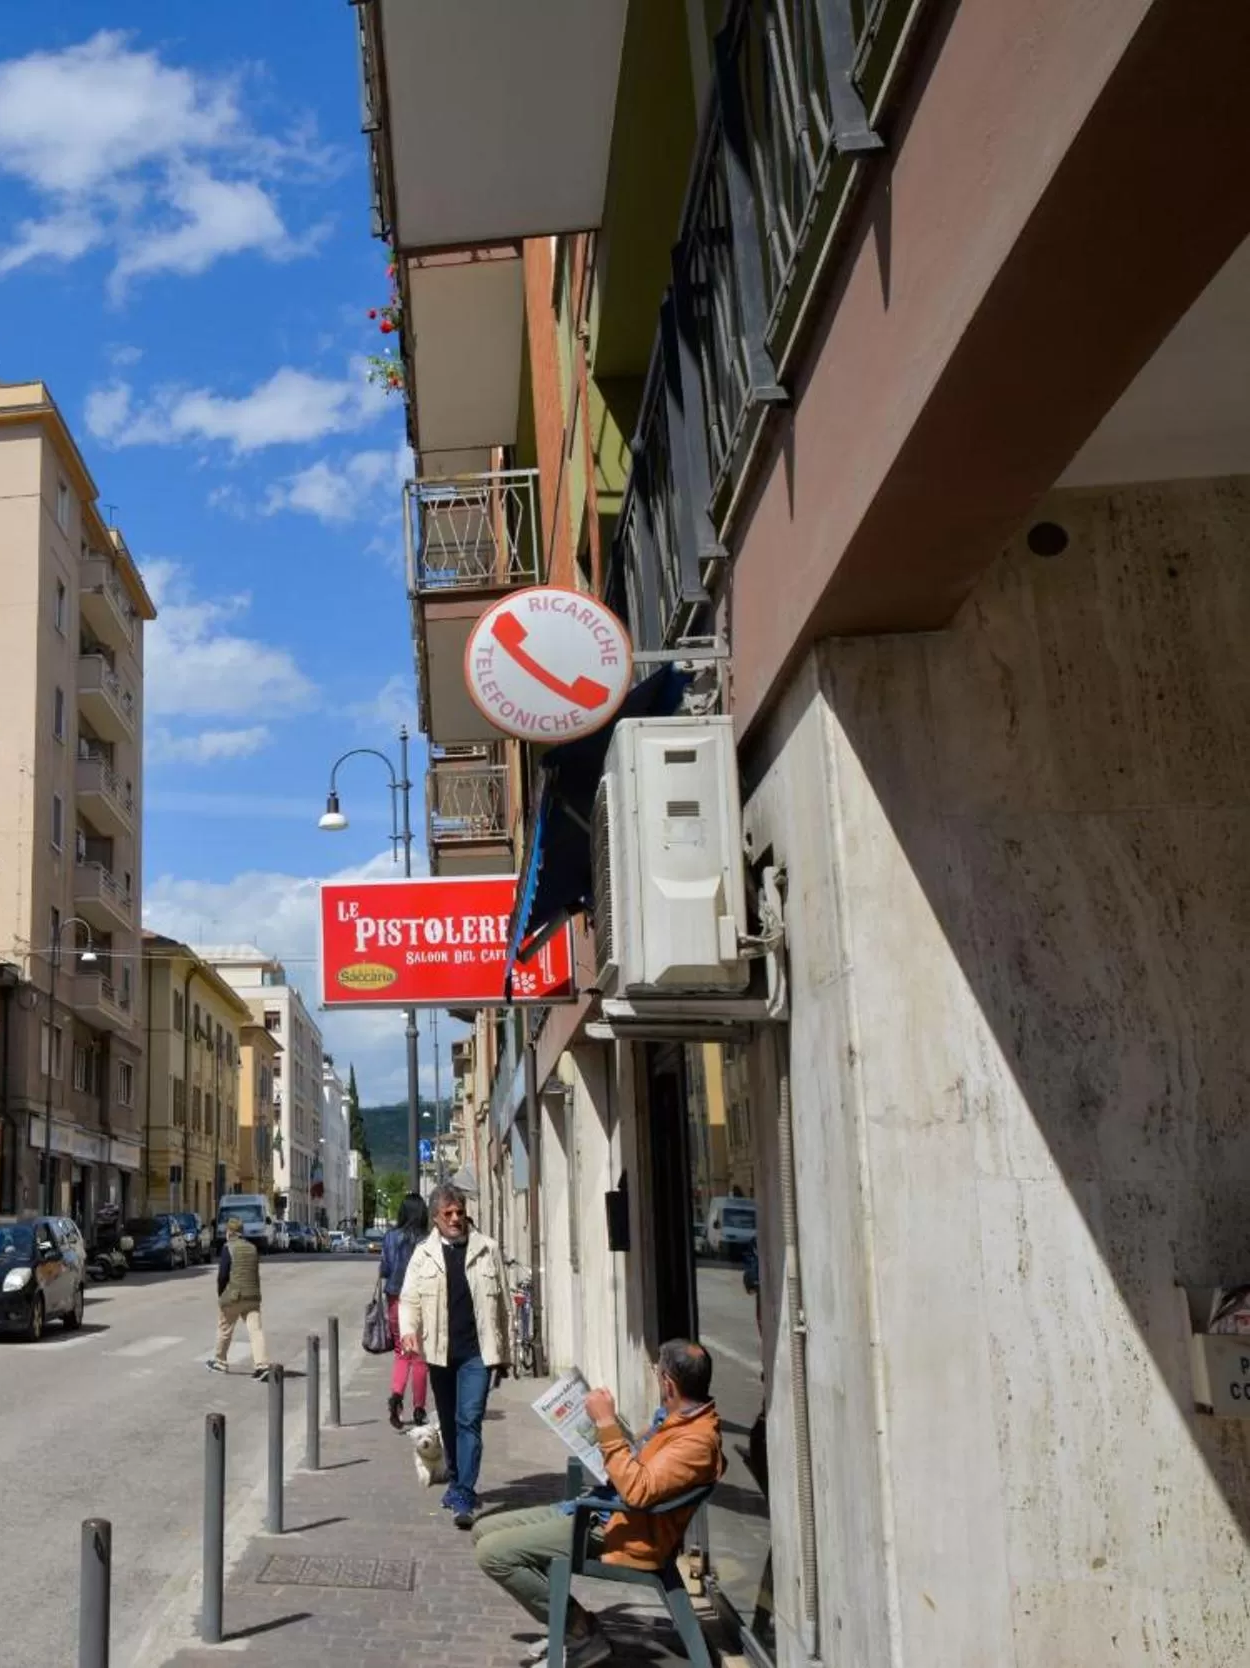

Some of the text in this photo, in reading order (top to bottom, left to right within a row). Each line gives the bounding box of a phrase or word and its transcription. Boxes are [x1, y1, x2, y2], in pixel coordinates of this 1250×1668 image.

[528, 597, 618, 666] RICARICHE
[476, 644, 584, 732] TELEFONICHE
[406, 951, 448, 965] SALOON
[454, 949, 475, 964] DEL
